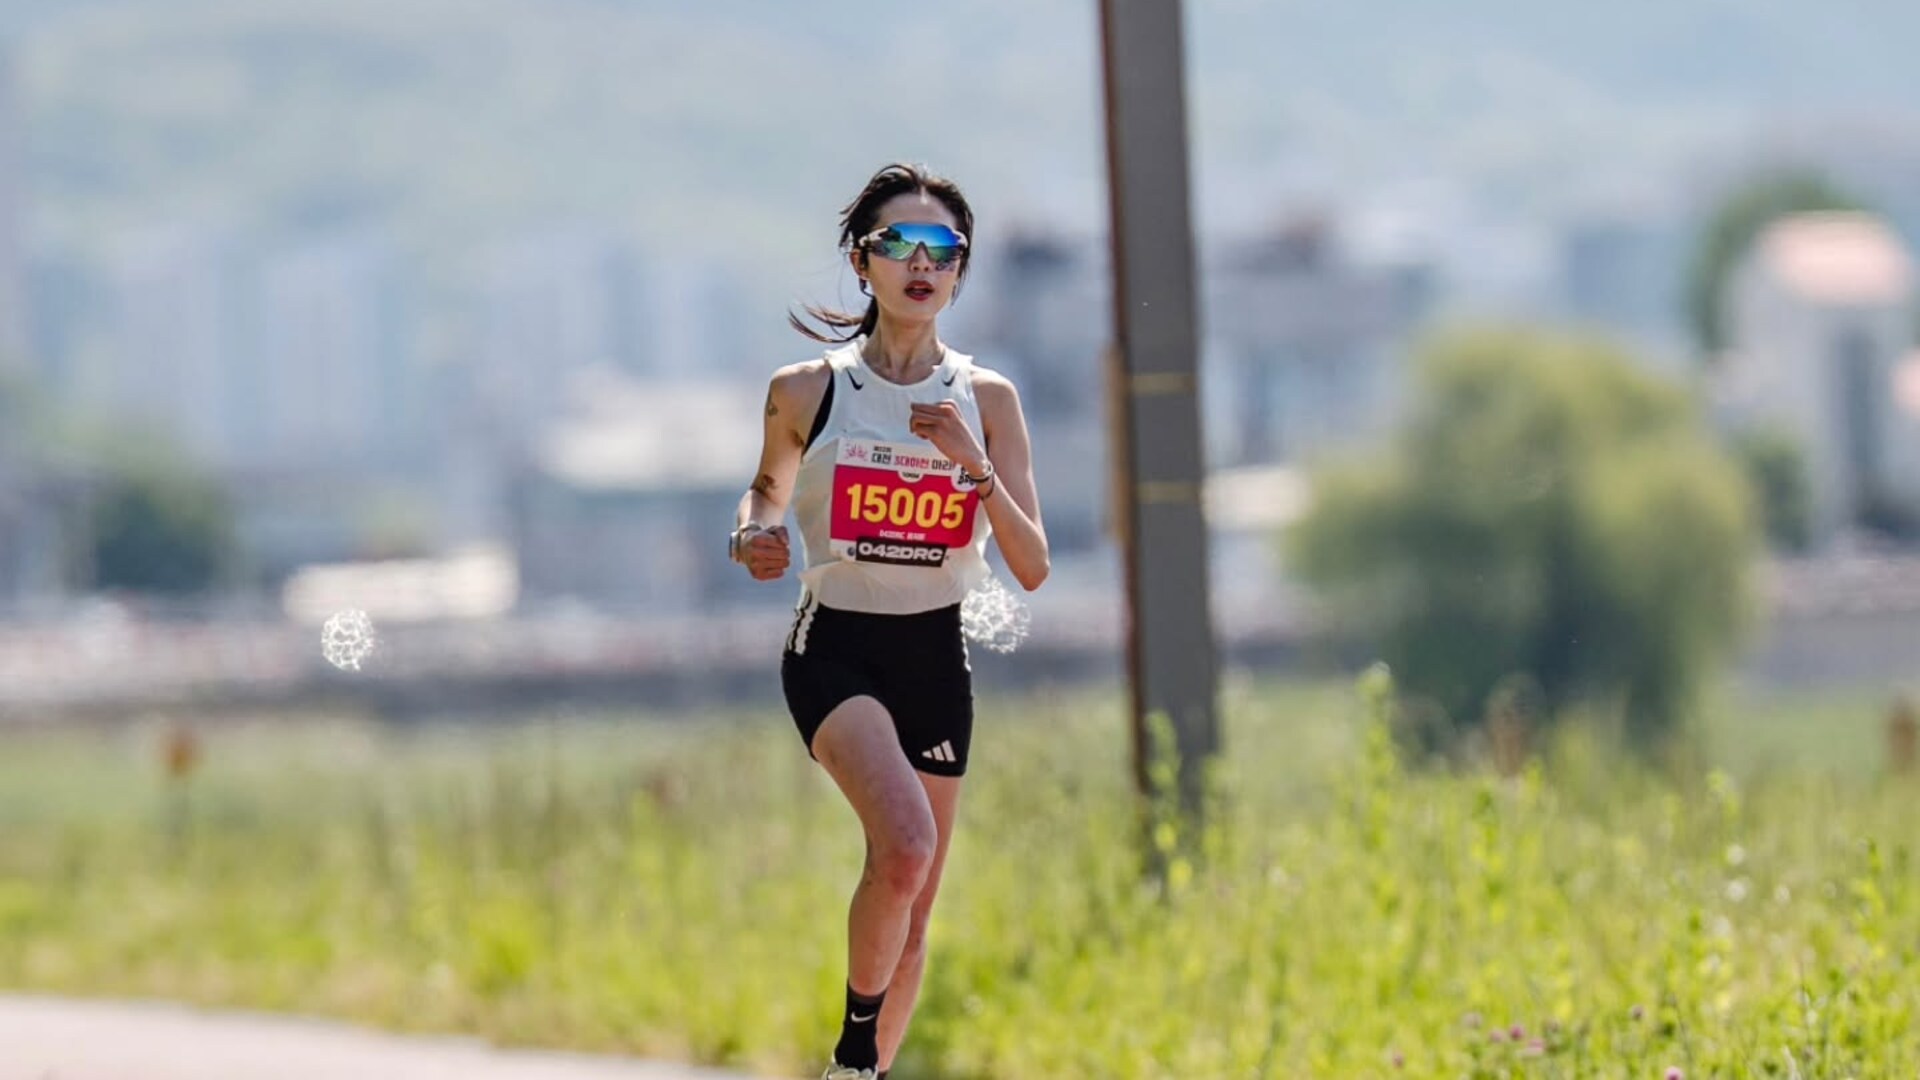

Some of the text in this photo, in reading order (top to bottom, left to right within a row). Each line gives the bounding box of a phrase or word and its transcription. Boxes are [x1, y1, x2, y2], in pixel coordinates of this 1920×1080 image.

[871, 452, 891, 465] 대전
[931, 459, 955, 471] 마라
[847, 483, 968, 529] 15005
[858, 542, 943, 561] 042DRC
